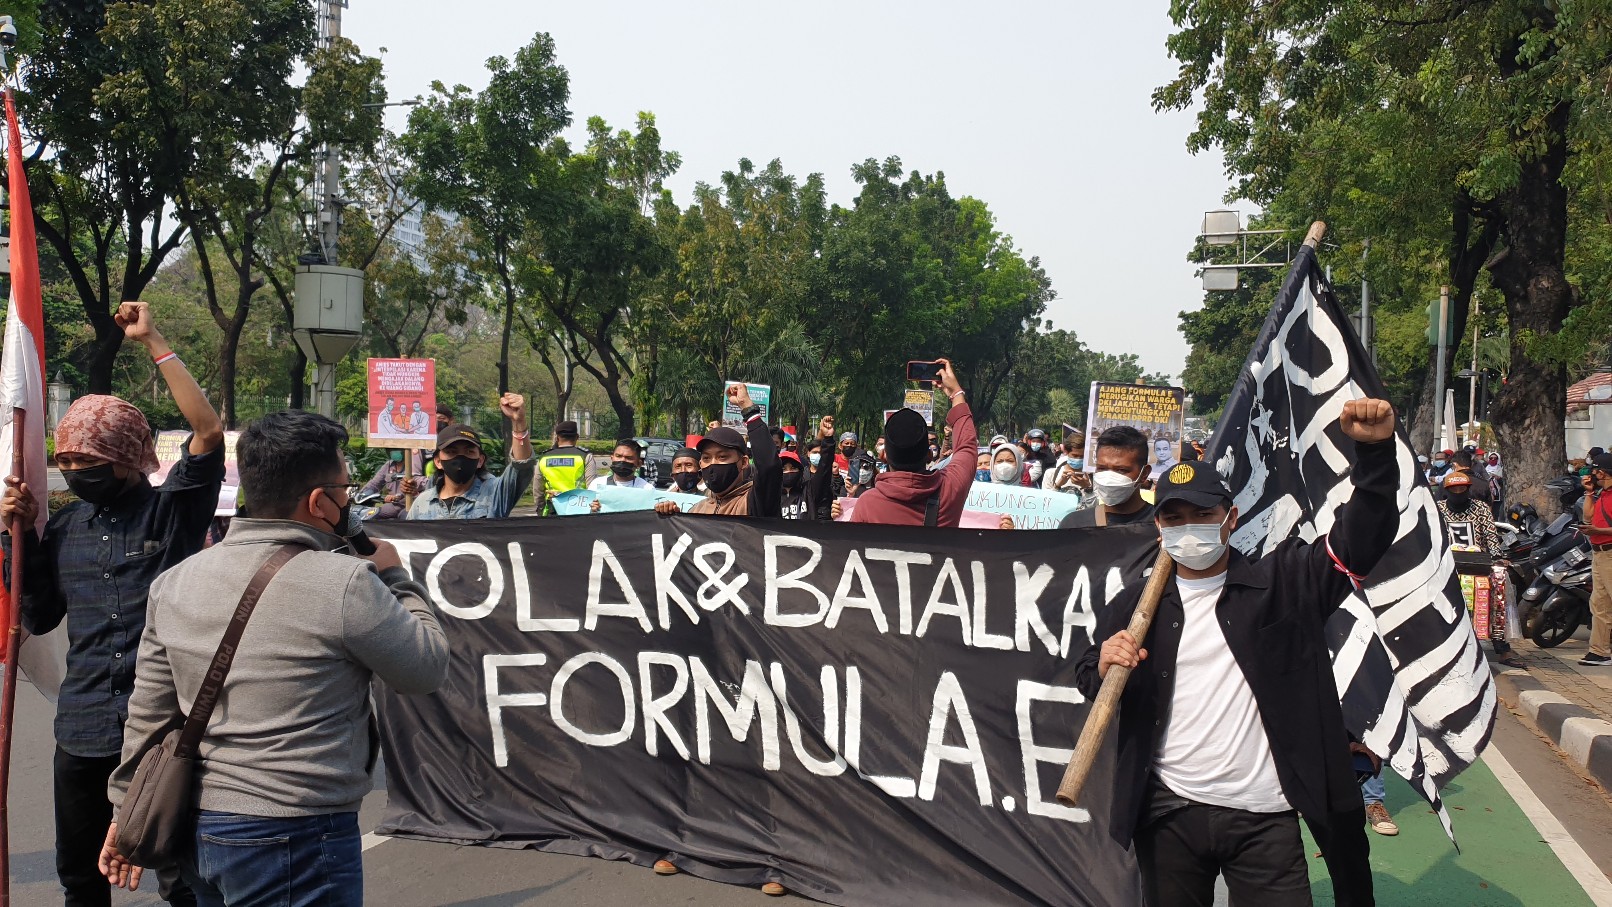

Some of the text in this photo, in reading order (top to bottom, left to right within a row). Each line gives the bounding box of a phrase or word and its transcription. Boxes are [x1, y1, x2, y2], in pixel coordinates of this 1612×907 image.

[1100, 385, 1173, 398] AJANG FORMULA E
[1099, 393, 1176, 404] MERUGIKAN WARGA
[1097, 405, 1170, 417] MENGUNTUNGKAN
[1112, 400, 1151, 410] JAKARTA,
[1153, 402, 1180, 412] TETAPI
[1102, 412, 1130, 420] FRAKSI
[1131, 414, 1153, 423] DPRD
[1154, 416, 1169, 424] DKI
[548, 458, 574, 467] POLISI
[192, 642, 234, 722] POLO TWIN
